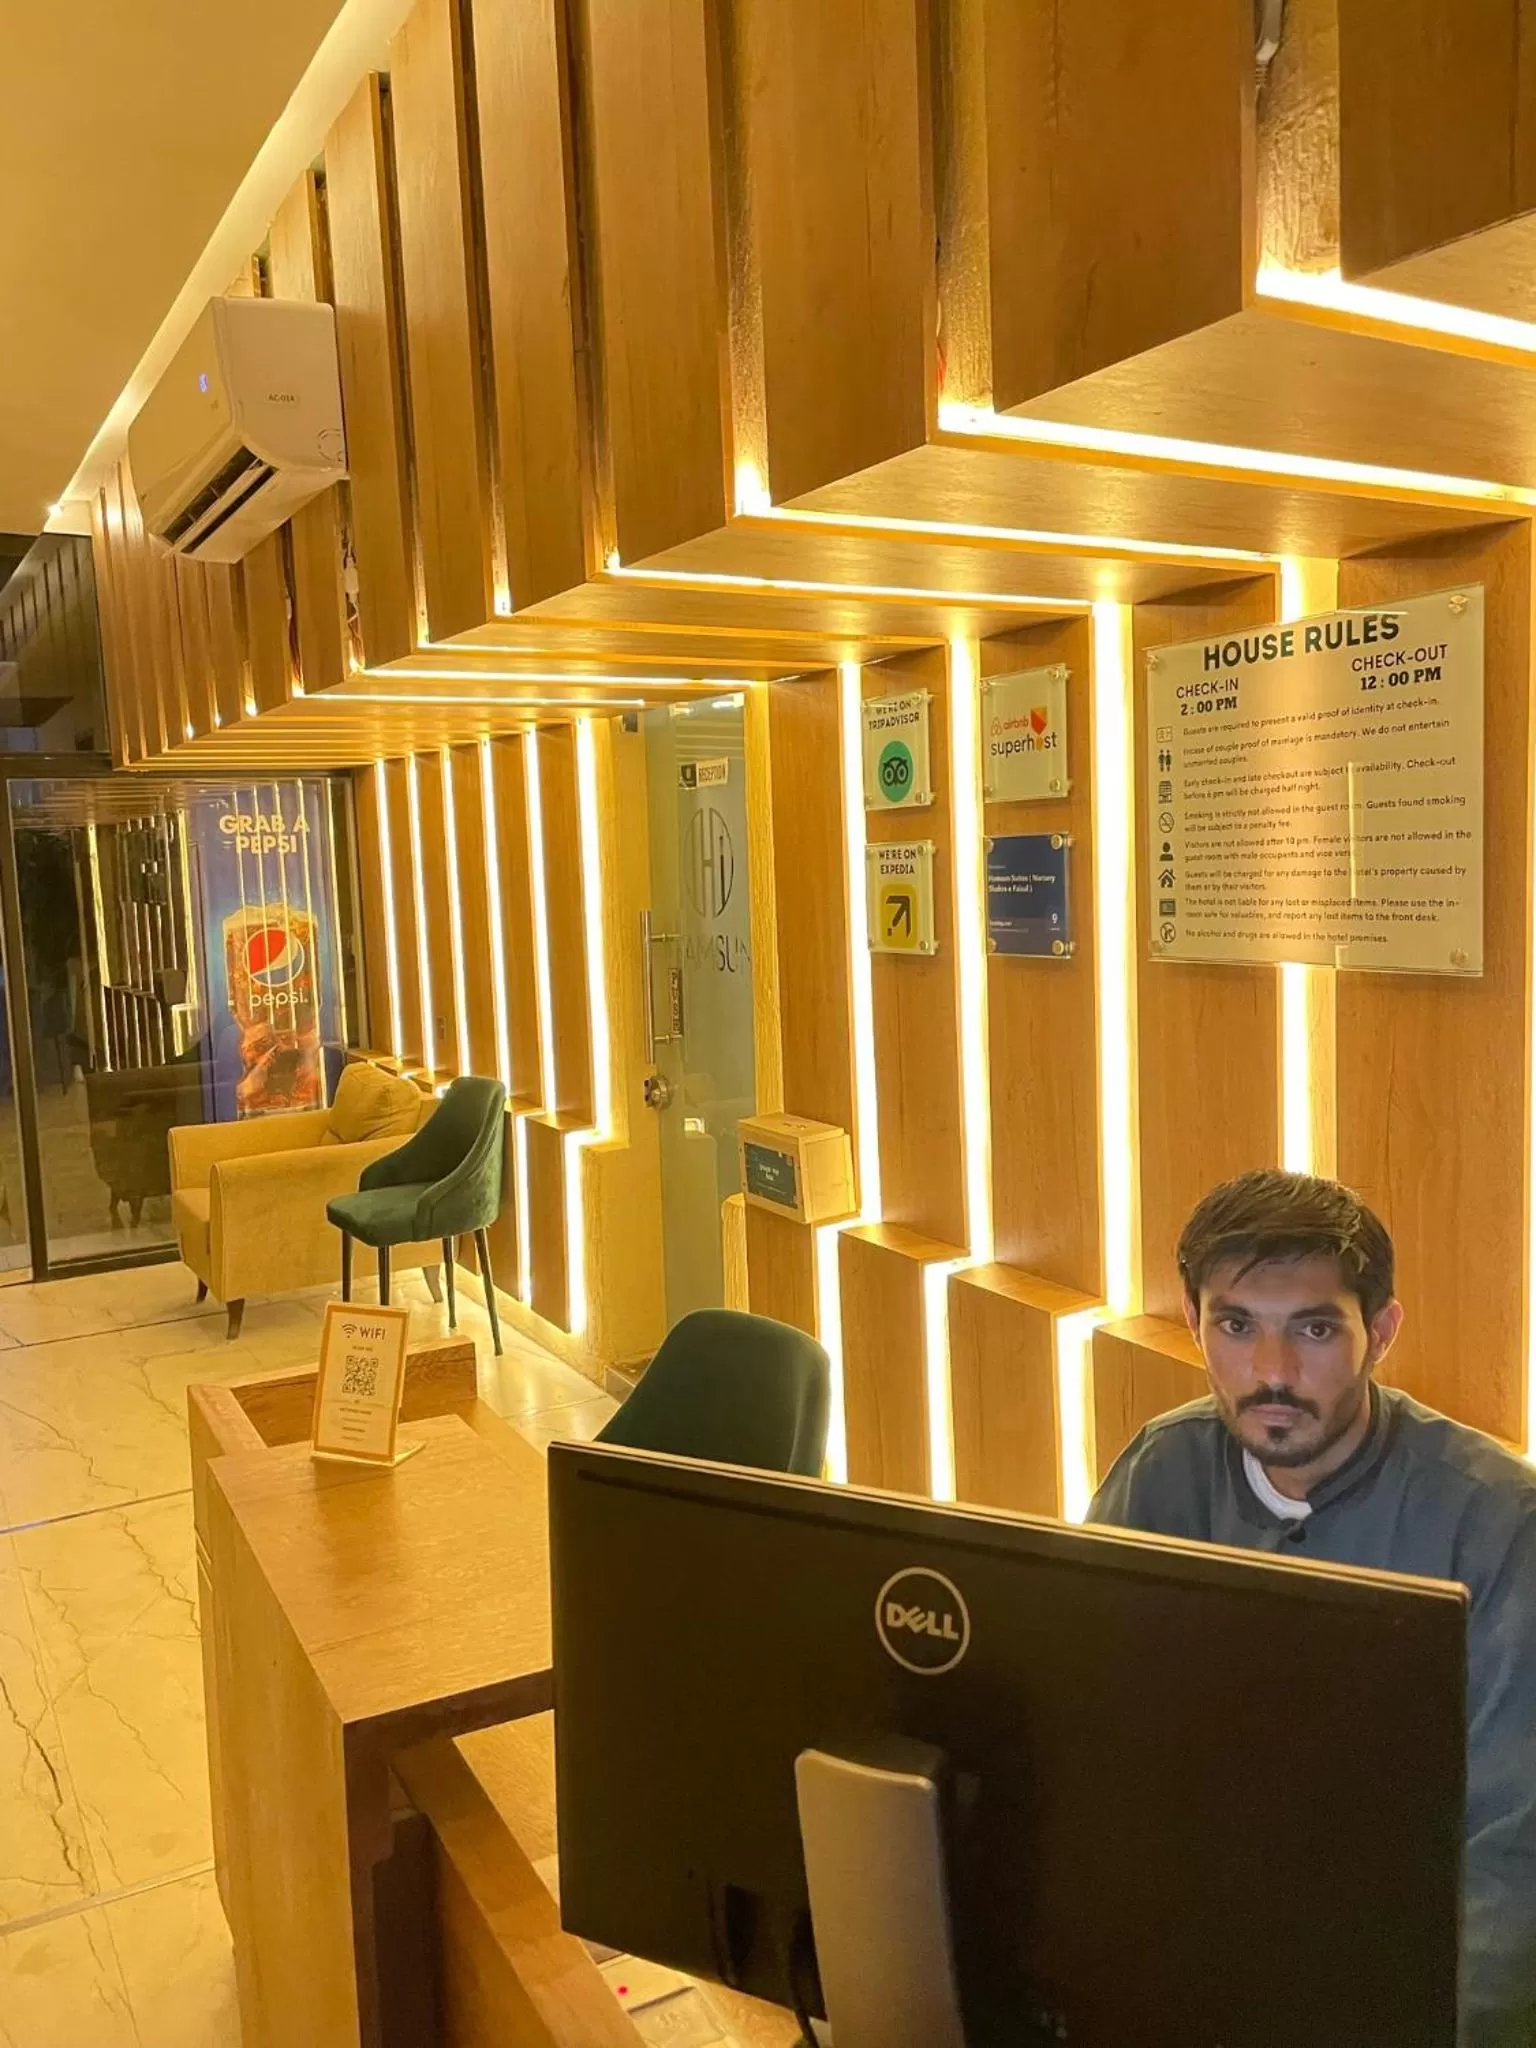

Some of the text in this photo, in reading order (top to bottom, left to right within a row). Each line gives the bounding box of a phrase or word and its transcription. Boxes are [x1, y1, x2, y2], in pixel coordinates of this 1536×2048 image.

[1203, 614, 1400, 671] HOUSE RULES
[1351, 644, 1448, 672] CHECK-OUT
[1414, 666, 1442, 683] PM
[1176, 677, 1239, 699] CHECK-IN
[1216, 696, 1237, 710] PM
[1220, 720, 1250, 733] required
[1251, 720, 1260, 728] to
[1298, 711, 1316, 721] valid
[1318, 708, 1339, 720] proof
[1341, 708, 1350, 717] of
[1351, 703, 1384, 716] identity
[1386, 702, 1395, 711] at
[1241, 739, 1260, 751] proof
[1261, 738, 1269, 747] of
[1362, 727, 1376, 737] We
[1378, 725, 1390, 735] do
[1391, 723, 1405, 733] not
[1408, 719, 1449, 732] entertain
[1248, 773, 1262, 782] late
[1300, 770, 1312, 778] are
[1314, 766, 1343, 778] subject
[1407, 756, 1456, 769] Check-out
[1239, 787, 1248, 796] be
[1250, 785, 1280, 797] charged
[1282, 784, 1296, 793] half
[1248, 808, 1260, 817] not
[1261, 805, 1291, 815] allowed
[1292, 804, 1300, 813] in
[1302, 804, 1315, 813] the
[1316, 803, 1339, 814] guest
[1366, 800, 1396, 809] Guests
[1398, 797, 1424, 808] found
[1427, 795, 1466, 807] smoking
[219, 814, 310, 835] GRAB A
[1208, 823, 1233, 833] subject
[1249, 820, 1276, 831] penalty
[235, 834, 297, 855] PEPSI
[1236, 839, 1265, 848] allowed
[1313, 834, 1341, 845] Female
[1375, 833, 1389, 842] are
[1390, 832, 1406, 842] not
[1407, 830, 1442, 840] allowed
[1445, 829, 1454, 839] in
[1456, 829, 1472, 839] the
[903, 849, 916, 860] ON
[1300, 850, 1315, 858] and
[880, 863, 916, 875] EXPEDIA
[1223, 870, 1233, 878] be
[1264, 869, 1275, 877] for
[1276, 870, 1289, 879] any
[1291, 868, 1322, 879] damage
[1323, 867, 1332, 876] to
[1333, 867, 1347, 877] the
[1380, 867, 1418, 879] property
[1420, 865, 1452, 876] caused
[1455, 865, 1467, 877] by
[1259, 898, 1269, 907] for
[1285, 898, 1300, 907] lost
[1381, 898, 1408, 908] Please
[1410, 899, 1426, 908] use
[1428, 898, 1443, 908] the
[1268, 911, 1282, 919] and
[1283, 911, 1306, 921] report
[1308, 912, 1322, 922] any
[1324, 911, 1339, 920] lost
[1340, 911, 1364, 921] items
[1365, 912, 1375, 921] to
[1376, 912, 1389, 921] the
[1391, 912, 1414, 922] front
[1223, 930, 1236, 938] and
[1313, 932, 1326, 941] the
[1327, 932, 1348, 942] hotel
[359, 1325, 386, 1340] WIFI
[886, 1601, 960, 1641] DELL
